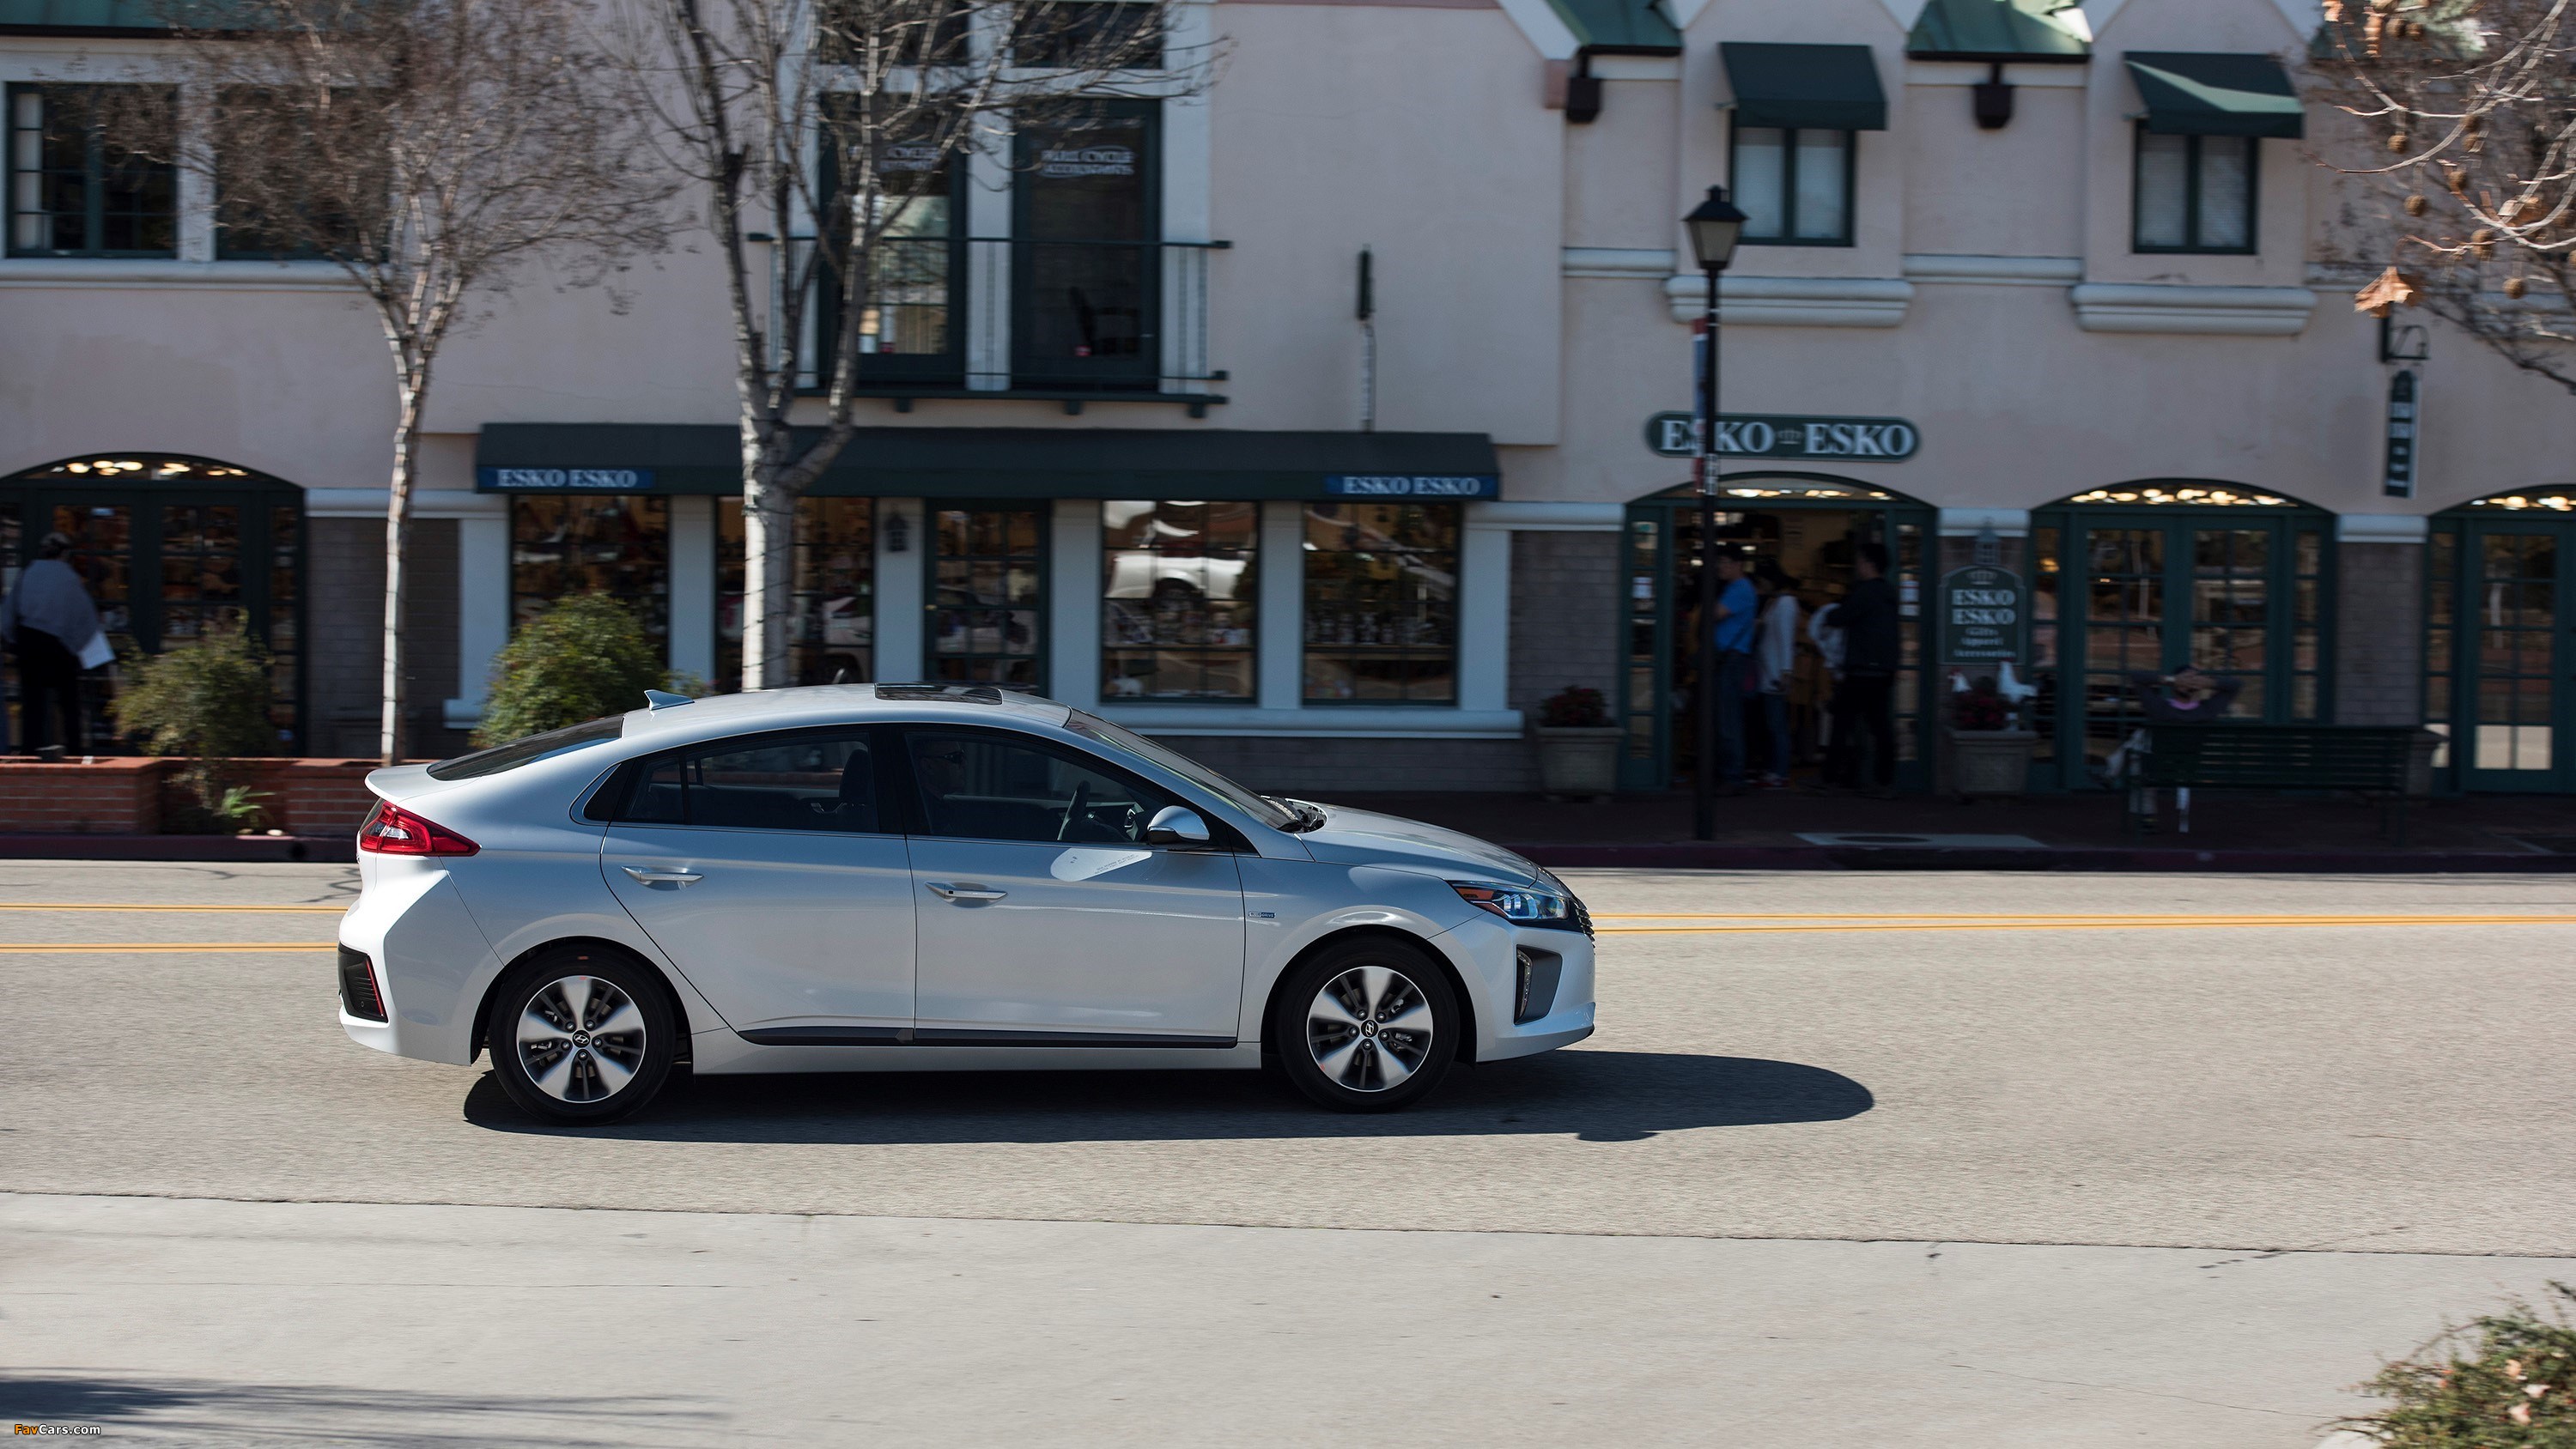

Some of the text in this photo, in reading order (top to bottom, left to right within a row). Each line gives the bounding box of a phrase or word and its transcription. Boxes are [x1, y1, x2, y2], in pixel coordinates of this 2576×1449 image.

[1660, 420, 1916, 456] EKO ESKO
[496, 469, 638, 488] ESKO ESKO
[1342, 476, 1481, 495] ESKO ESKO
[1951, 588, 2016, 605] ESKO
[1951, 609, 2016, 625] ESKO
